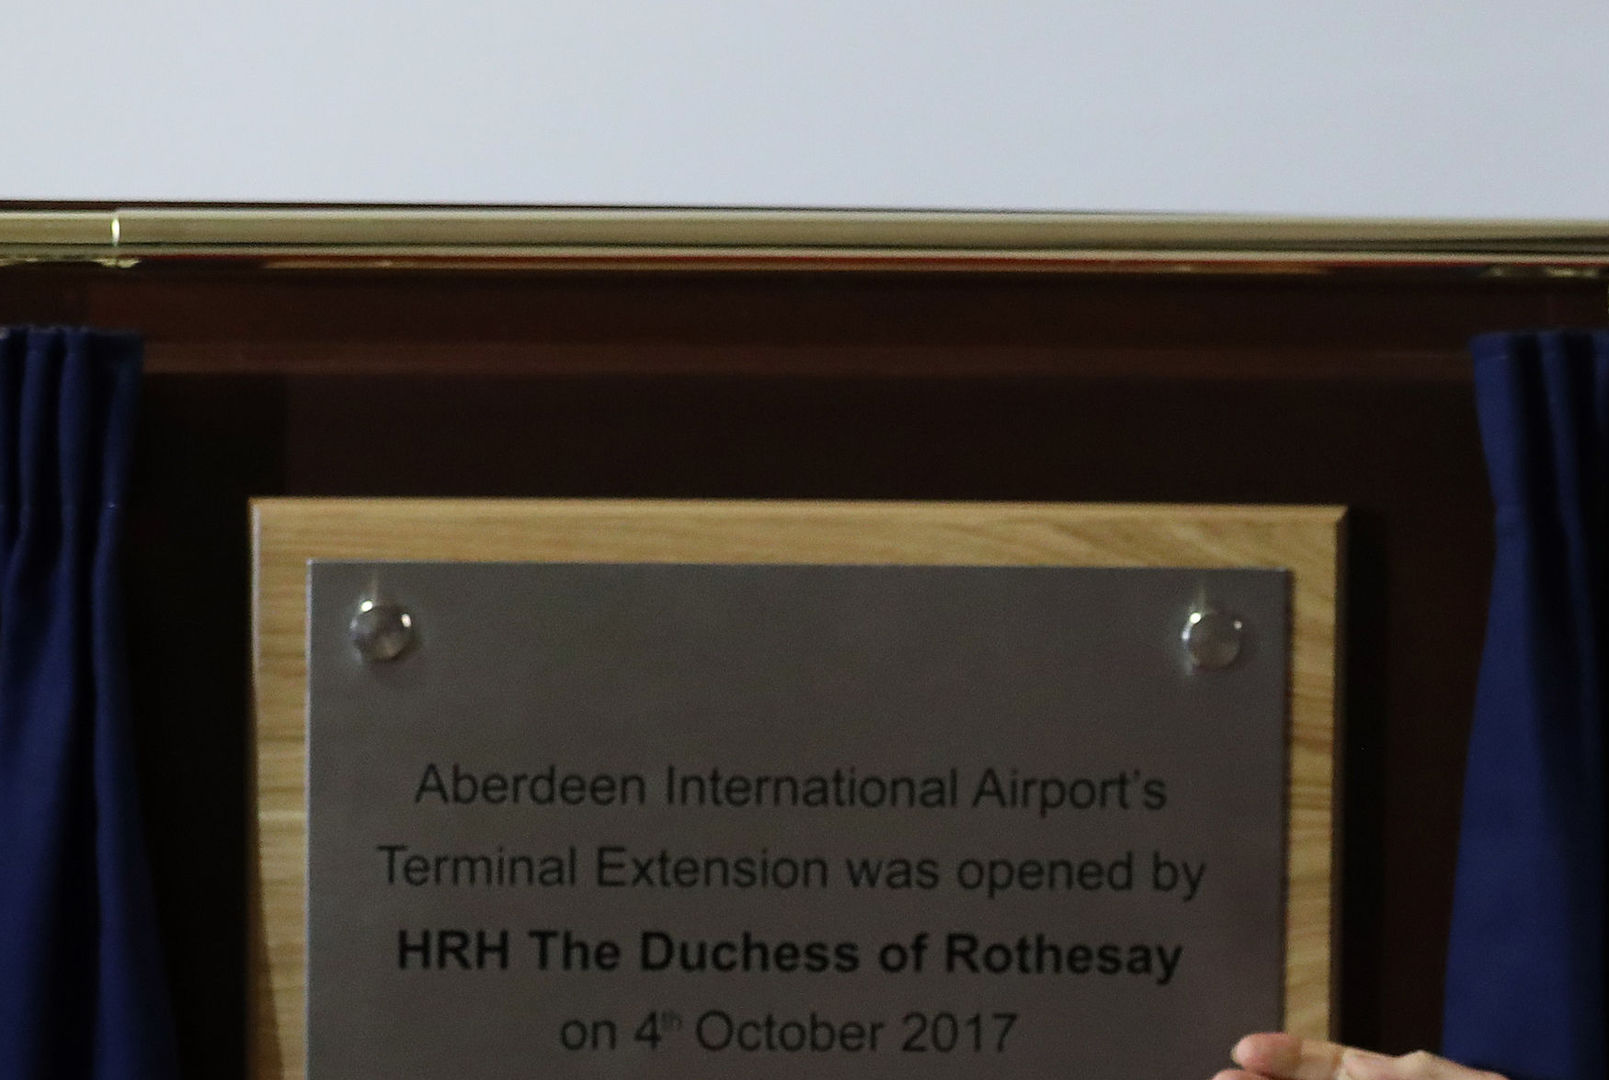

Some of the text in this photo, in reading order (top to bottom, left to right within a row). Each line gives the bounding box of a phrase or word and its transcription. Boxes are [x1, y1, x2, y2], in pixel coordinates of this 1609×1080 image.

[414, 762, 1167, 819] Aberdeen International Airport's
[376, 843, 1206, 902] Terminal Extension was opened by
[397, 928, 1183, 987] HRH The Duchess of Rothesay
[559, 1018, 617, 1052] on
[695, 1009, 885, 1053] October
[901, 1011, 1018, 1054] 2017
